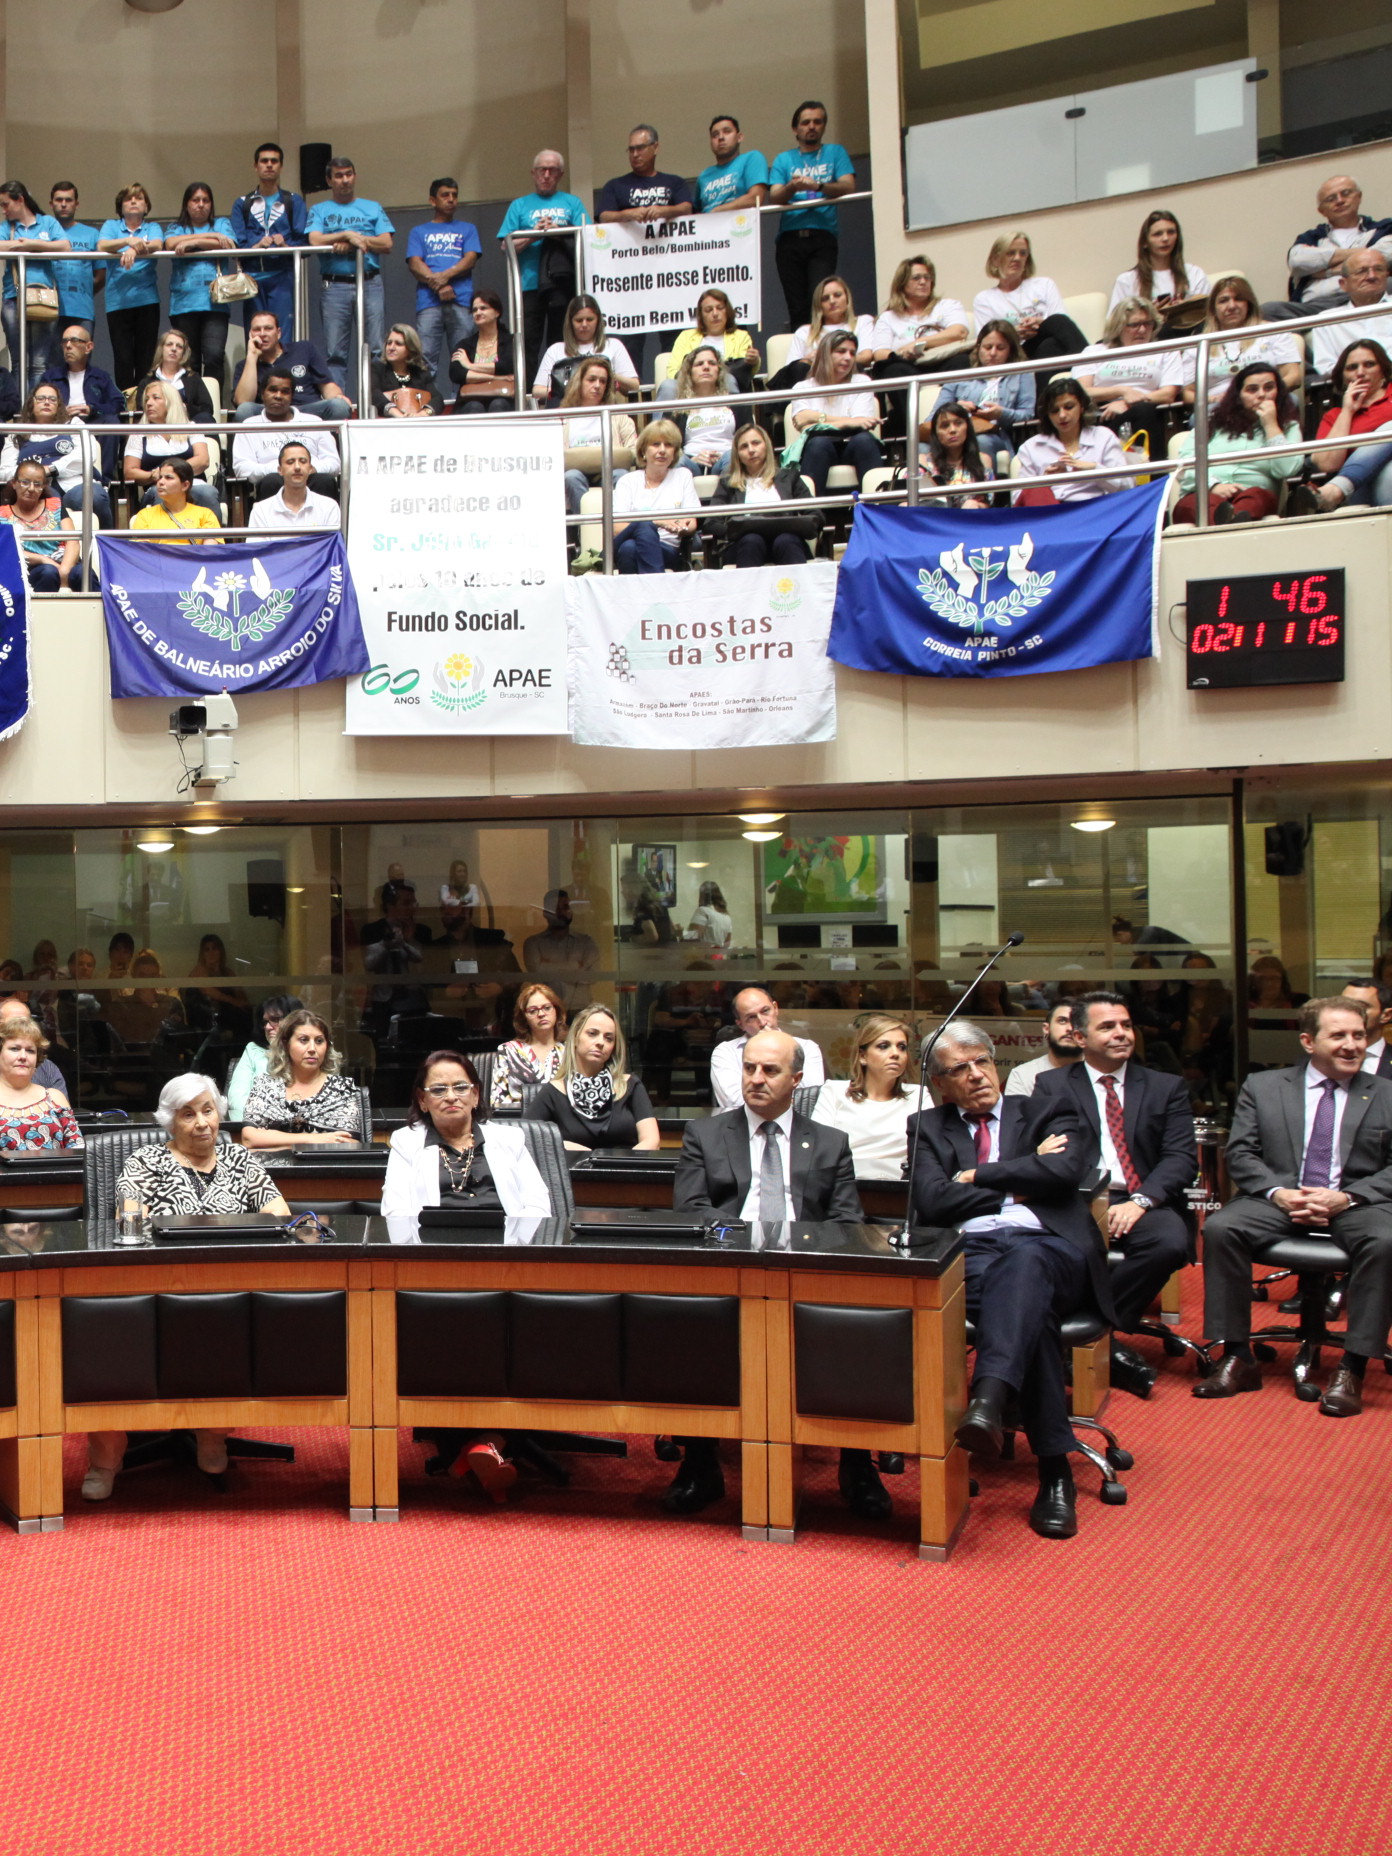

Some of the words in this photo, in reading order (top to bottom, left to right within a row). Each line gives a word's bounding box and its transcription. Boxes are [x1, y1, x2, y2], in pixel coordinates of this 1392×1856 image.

[645, 224, 655, 239] A
[659, 220, 696, 238] APAE
[611, 248, 639, 259] Porto
[642, 239, 730, 256] Belo/Bombinhas
[592, 273, 653, 293] Presente
[657, 270, 699, 289] nesse
[703, 265, 753, 284] Evento.
[649, 309, 684, 326] Bem
[357, 456, 369, 475] A
[376, 455, 427, 475] APAE
[433, 454, 457, 473] de
[463, 454, 553, 475] Brusque
[390, 494, 490, 515] agradece
[496, 494, 521, 511] ao
[372, 533, 405, 551] Sr.
[1272, 575, 1328, 614] 46
[109, 582, 139, 623] APAE
[132, 618, 157, 646] DE
[153, 640, 254, 680] BALNEÁRIO
[257, 630, 317, 675] ARROIO
[314, 605, 334, 636] DO
[387, 611, 448, 632] Fundo
[455, 609, 525, 631] Social.
[640, 615, 773, 641] Encostas
[922, 636, 973, 661] CORREIA
[964, 636, 999, 648] APAE
[668, 645, 702, 666] da
[715, 641, 793, 664] Serra
[492, 668, 552, 688] APAE
[394, 697, 420, 705] ANOS
[499, 691, 527, 699] Brusque
